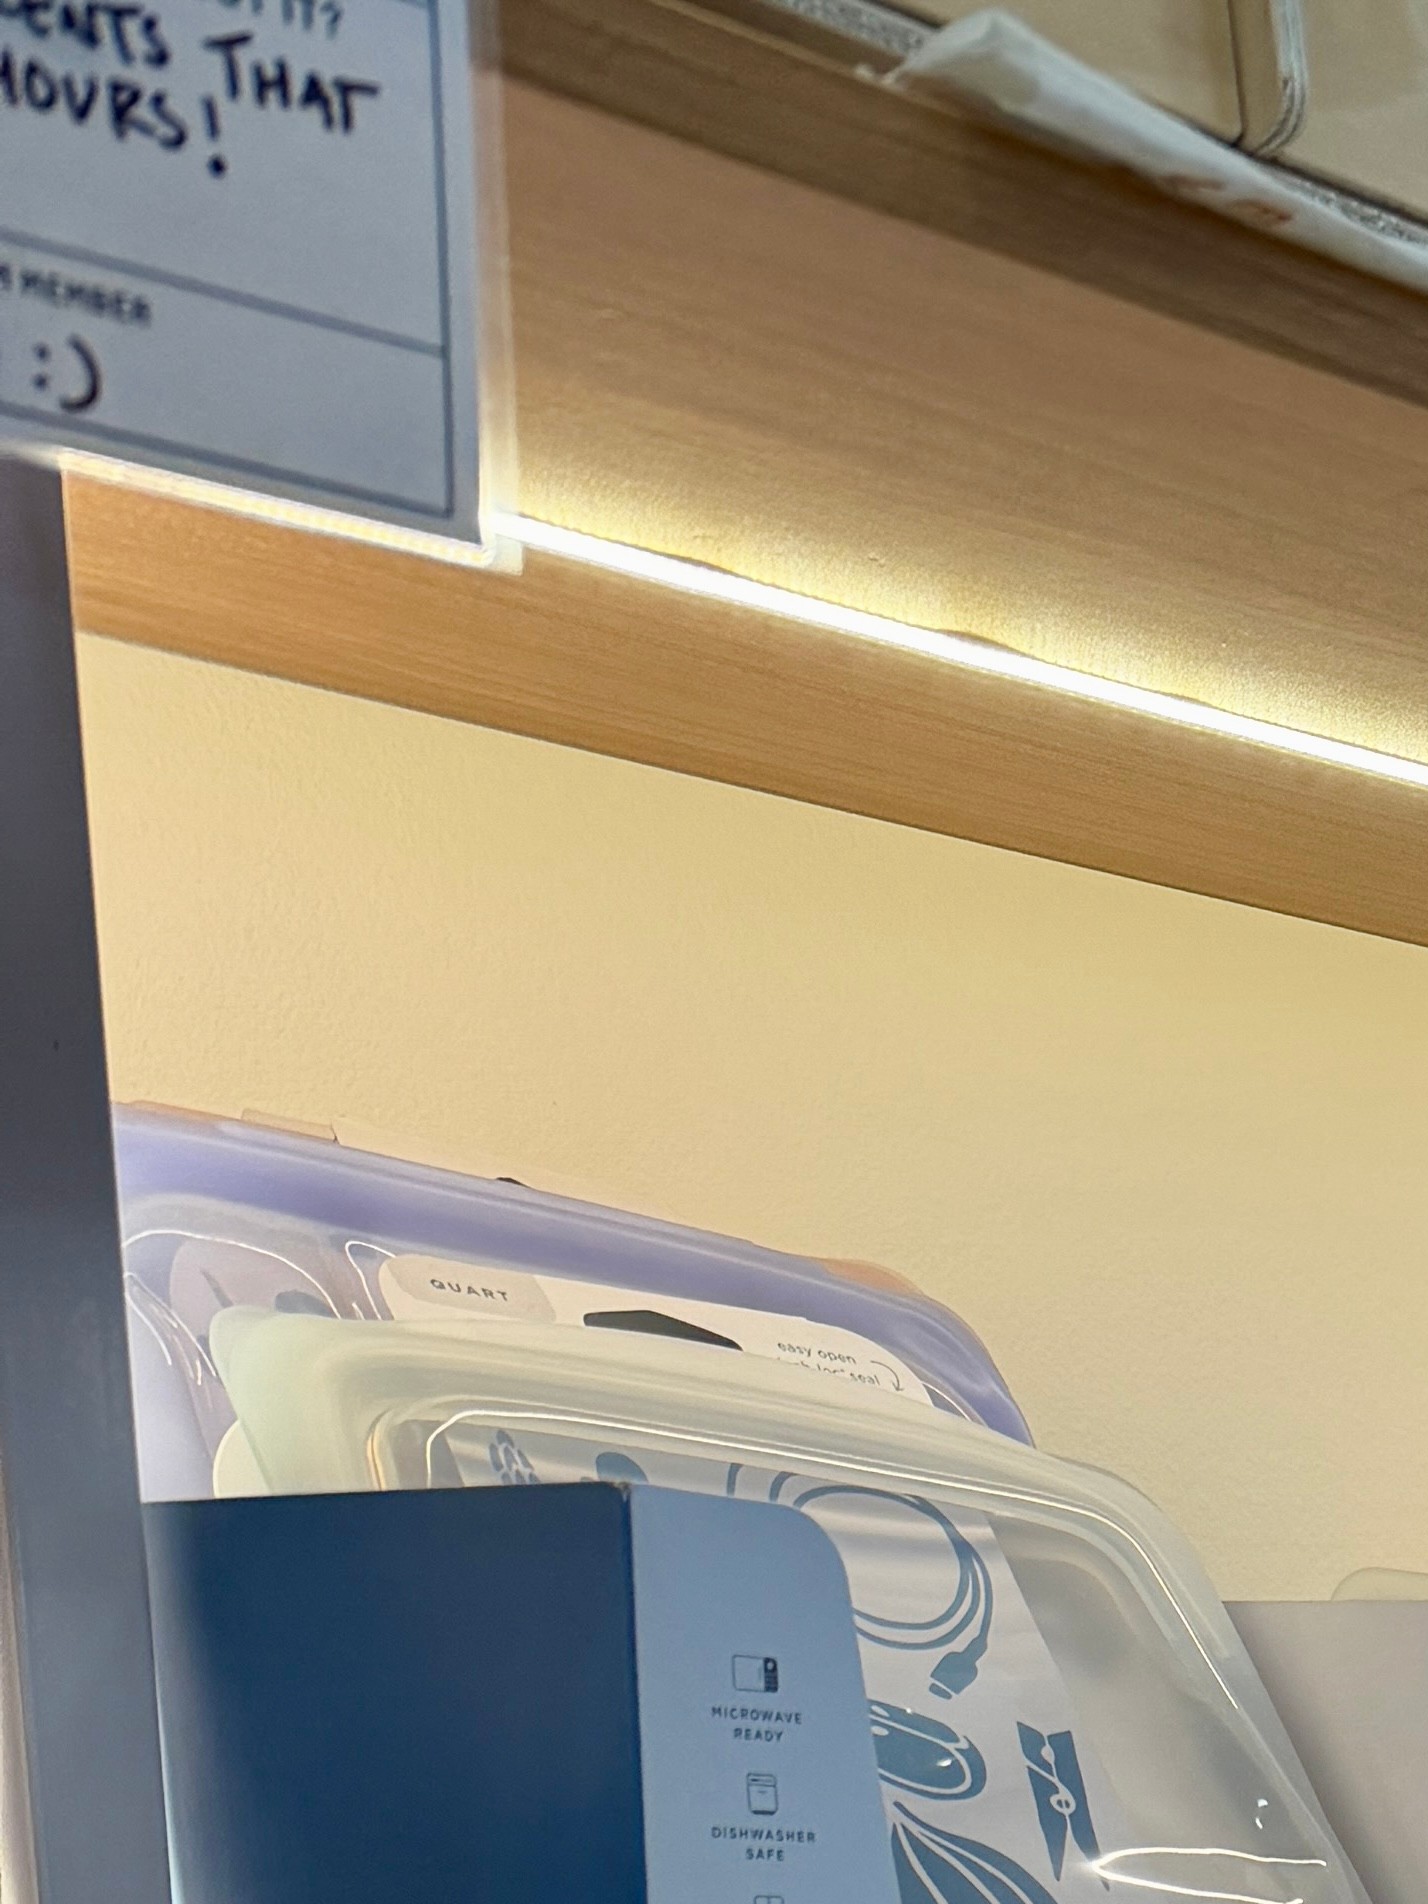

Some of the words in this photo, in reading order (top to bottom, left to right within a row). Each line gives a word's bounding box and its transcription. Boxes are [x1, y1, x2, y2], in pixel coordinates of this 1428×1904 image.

[204, 32, 381, 135] THAT
[428, 1277, 510, 1307] QUART
[775, 1338, 813, 1361] easy
[818, 1346, 858, 1370] open
[711, 1705, 803, 1726] MICROWAVE
[733, 1727, 784, 1743] READY
[710, 1826, 818, 1844] DISHWASHER
[745, 1848, 786, 1862] SAFE
